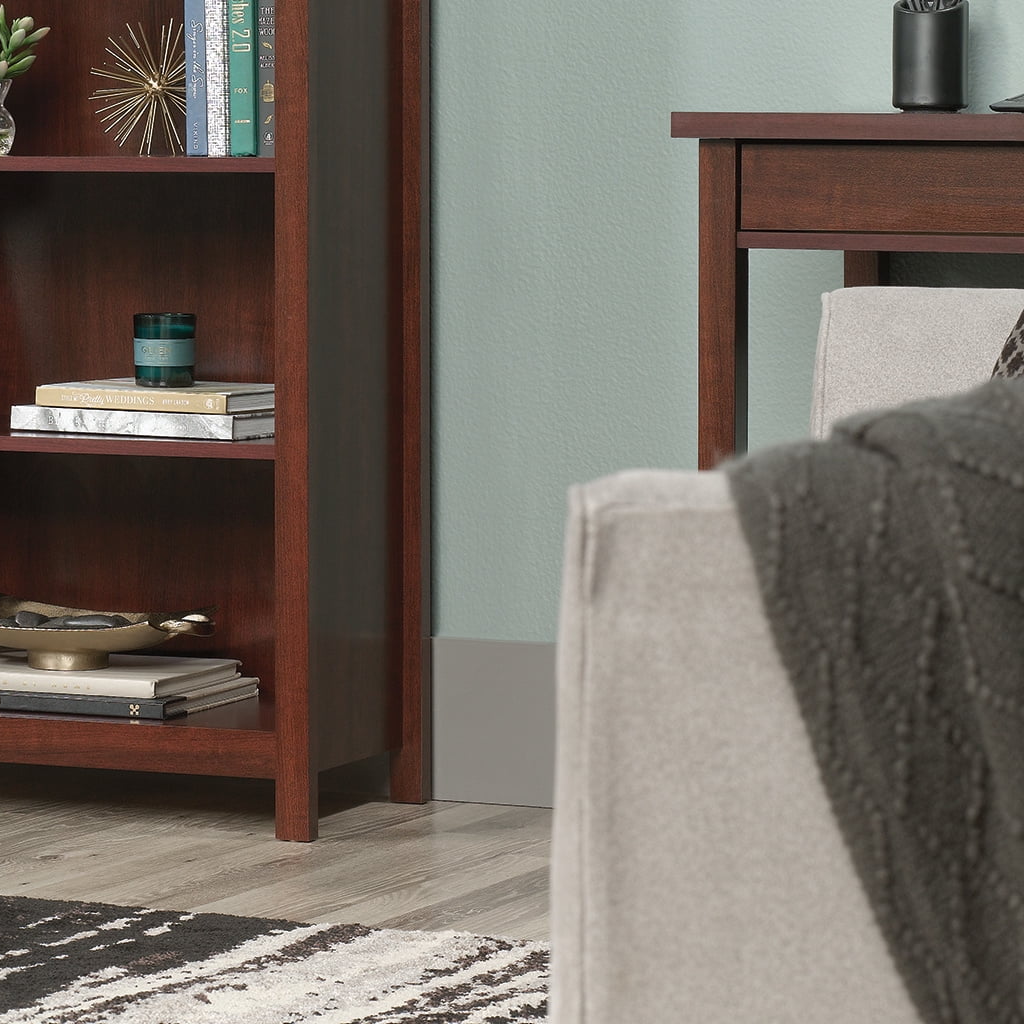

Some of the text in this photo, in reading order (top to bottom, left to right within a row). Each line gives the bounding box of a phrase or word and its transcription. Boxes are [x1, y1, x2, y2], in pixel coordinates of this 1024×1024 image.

[186, 20, 203, 48] Singer
[232, 29, 250, 52] 2.0
[193, 50, 199, 58] in
[193, 61, 204, 73] the
[106, 395, 155, 405] WEDDINGS
